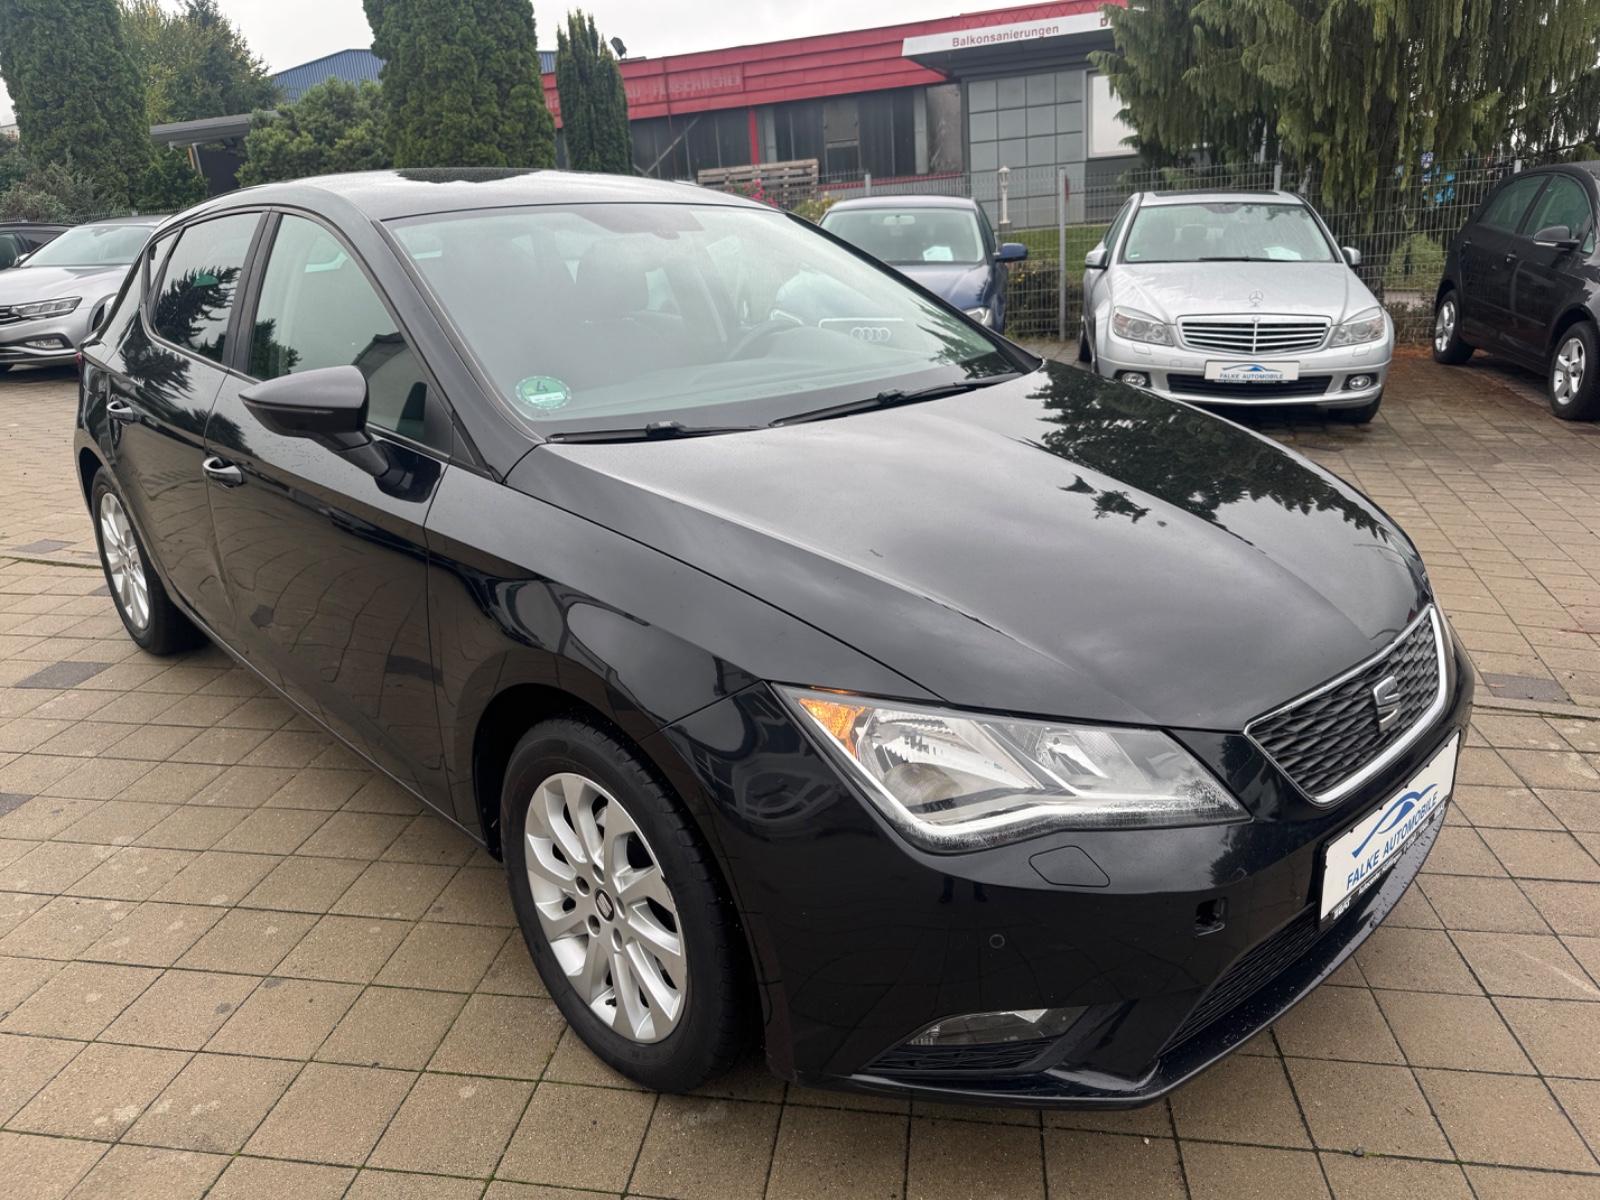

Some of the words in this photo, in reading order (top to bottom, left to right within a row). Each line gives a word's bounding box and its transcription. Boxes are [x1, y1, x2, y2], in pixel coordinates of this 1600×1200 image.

[952, 25, 1059, 47] Balkonsanierungen
[537, 381, 548, 392] 4
[1346, 849, 1380, 890] FALKE
[1382, 791, 1438, 858] AUTOMOBILE
